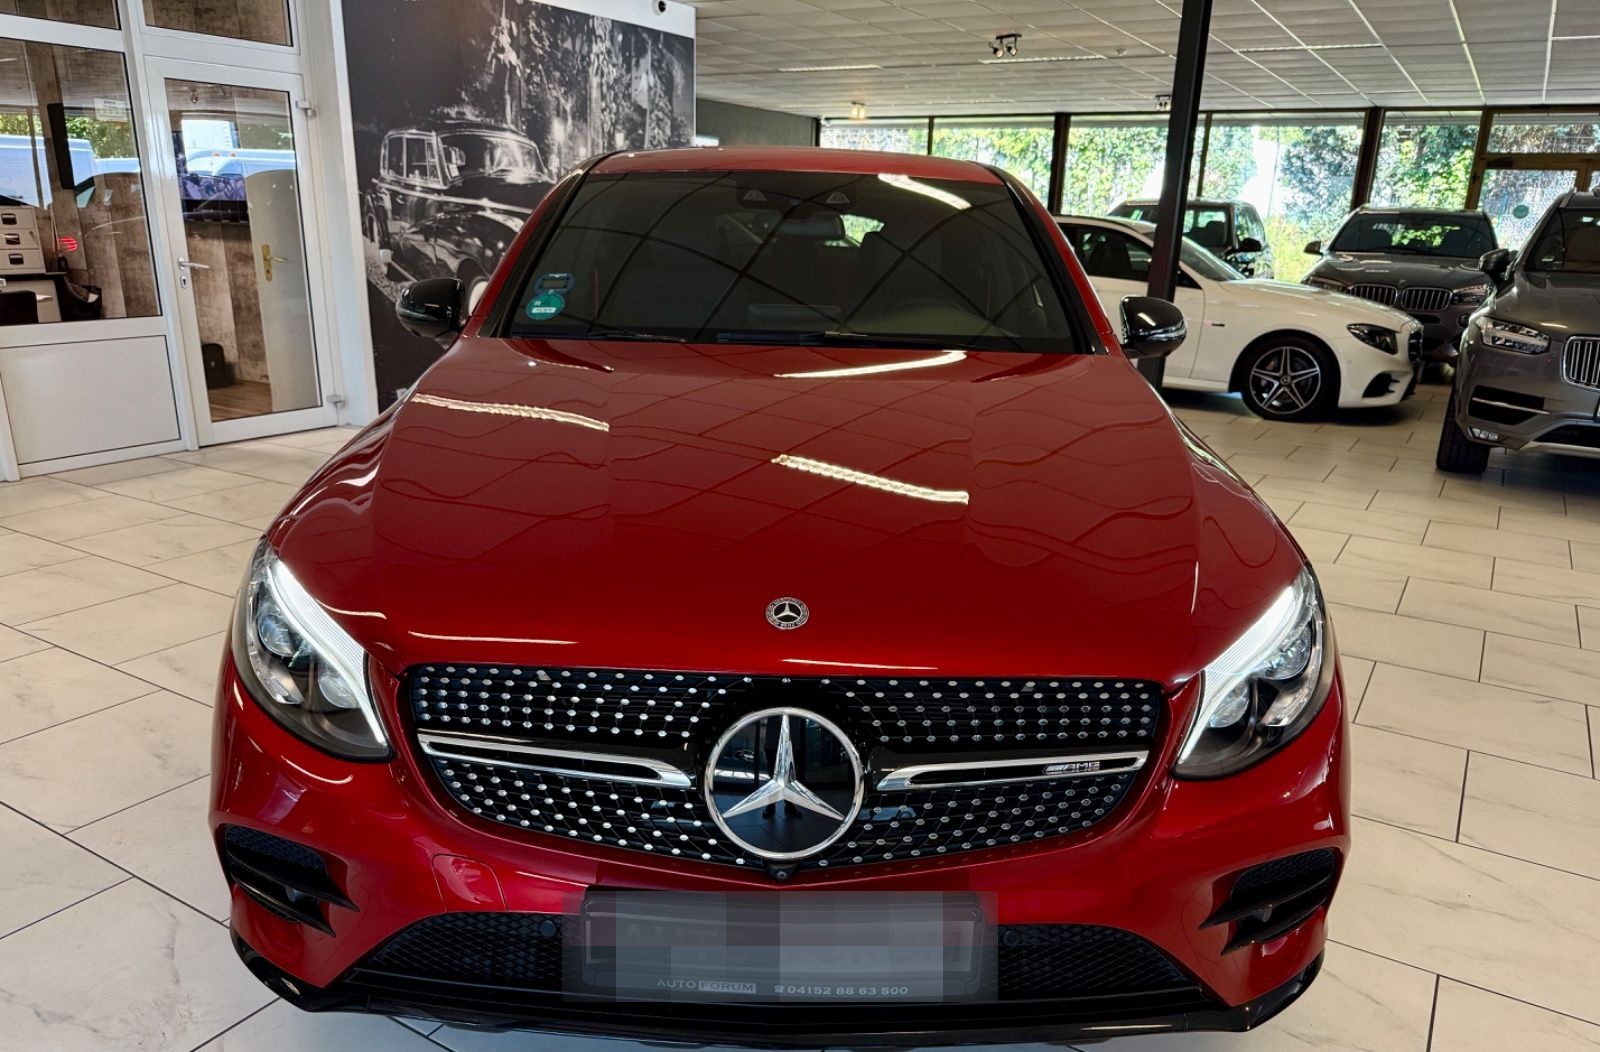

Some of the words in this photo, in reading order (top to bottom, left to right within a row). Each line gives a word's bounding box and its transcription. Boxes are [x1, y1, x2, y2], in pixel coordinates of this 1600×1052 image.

[656, 979, 696, 989] AUTO
[700, 981, 754, 992] FORUM
[787, 985, 832, 995] 04152
[836, 986, 855, 995] 88
[858, 986, 877, 995] 63
[881, 986, 909, 995] 500
